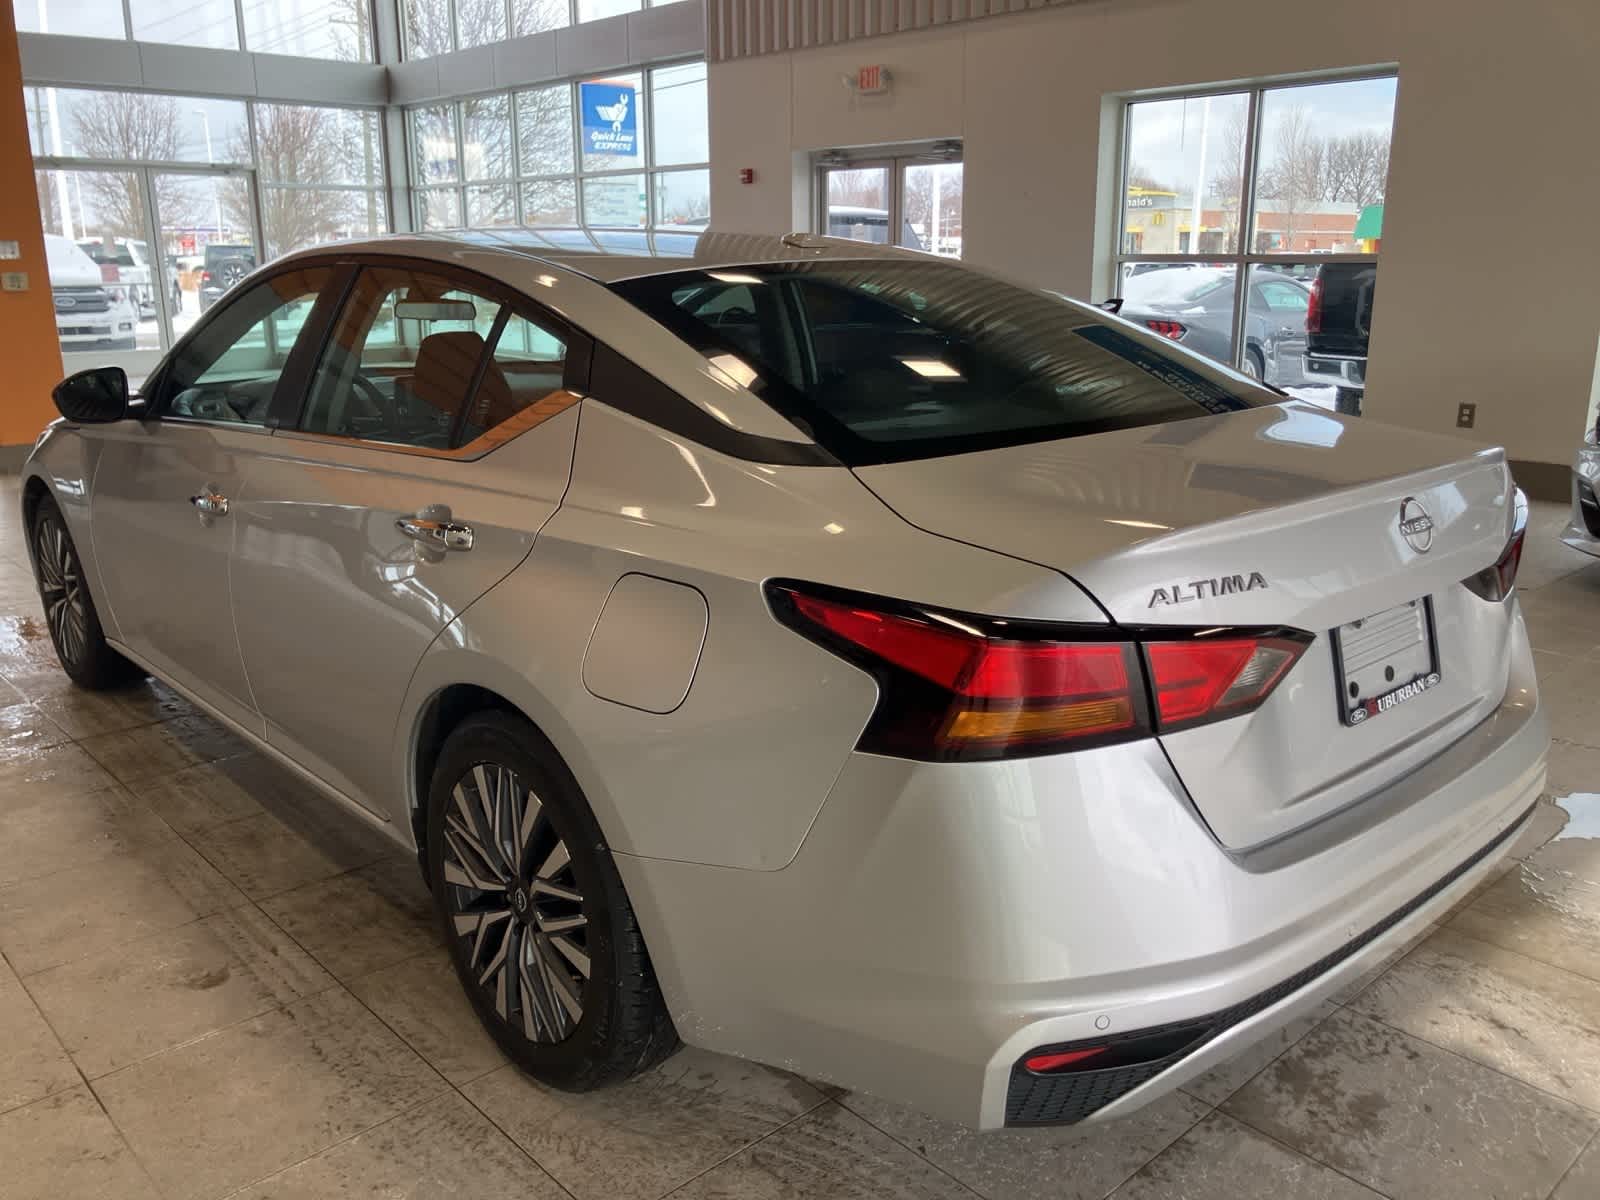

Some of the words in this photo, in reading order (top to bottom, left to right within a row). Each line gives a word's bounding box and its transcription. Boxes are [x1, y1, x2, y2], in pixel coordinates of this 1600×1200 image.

[858, 66, 881, 89] EXIT
[591, 131, 617, 141] Quick
[1401, 516, 1432, 535] NISS
[1147, 571, 1269, 609] ALTIMA
[1366, 678, 1425, 718] UBURBAN
